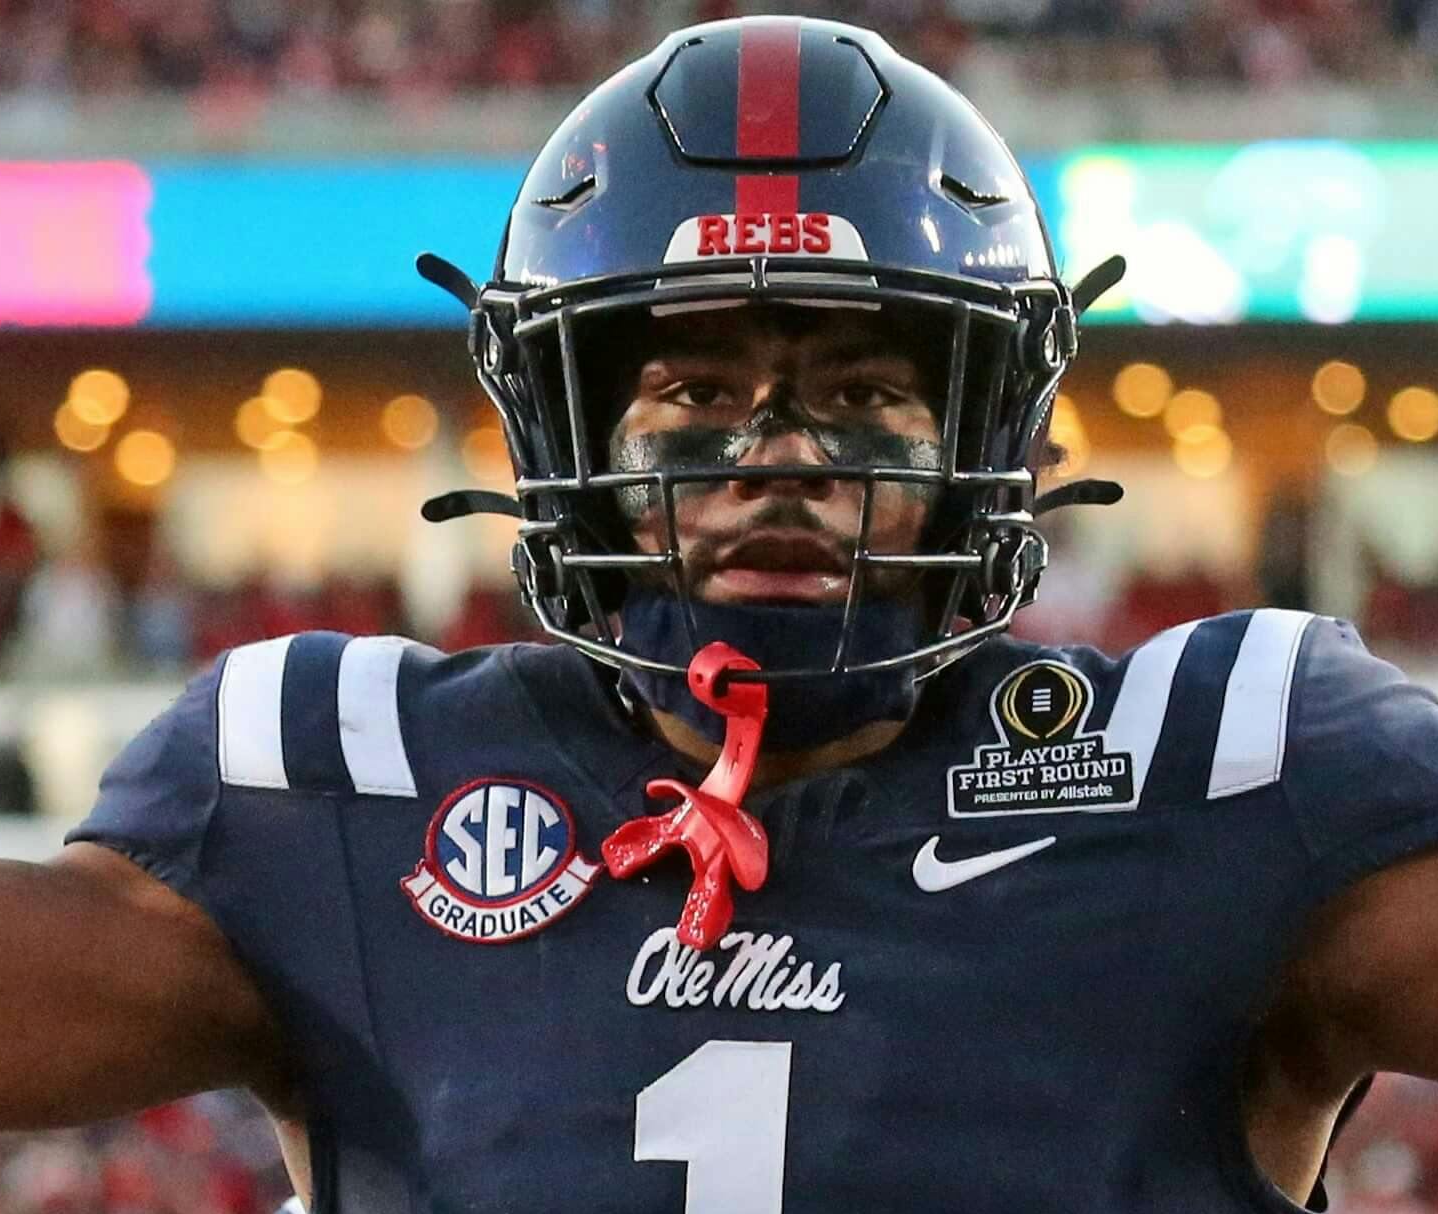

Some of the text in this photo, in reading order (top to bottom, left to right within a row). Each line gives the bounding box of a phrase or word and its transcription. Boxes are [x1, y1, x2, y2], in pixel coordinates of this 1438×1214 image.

[697, 213, 831, 256] REBS
[959, 758, 1127, 791] FIRST ROUND
[986, 740, 1097, 769] PLAYOFF
[974, 782, 1113, 804] PRESENTED BY Allstate
[442, 785, 560, 897] SEC
[428, 883, 573, 937] GRADUATE
[626, 927, 846, 1012] Ole Miss
